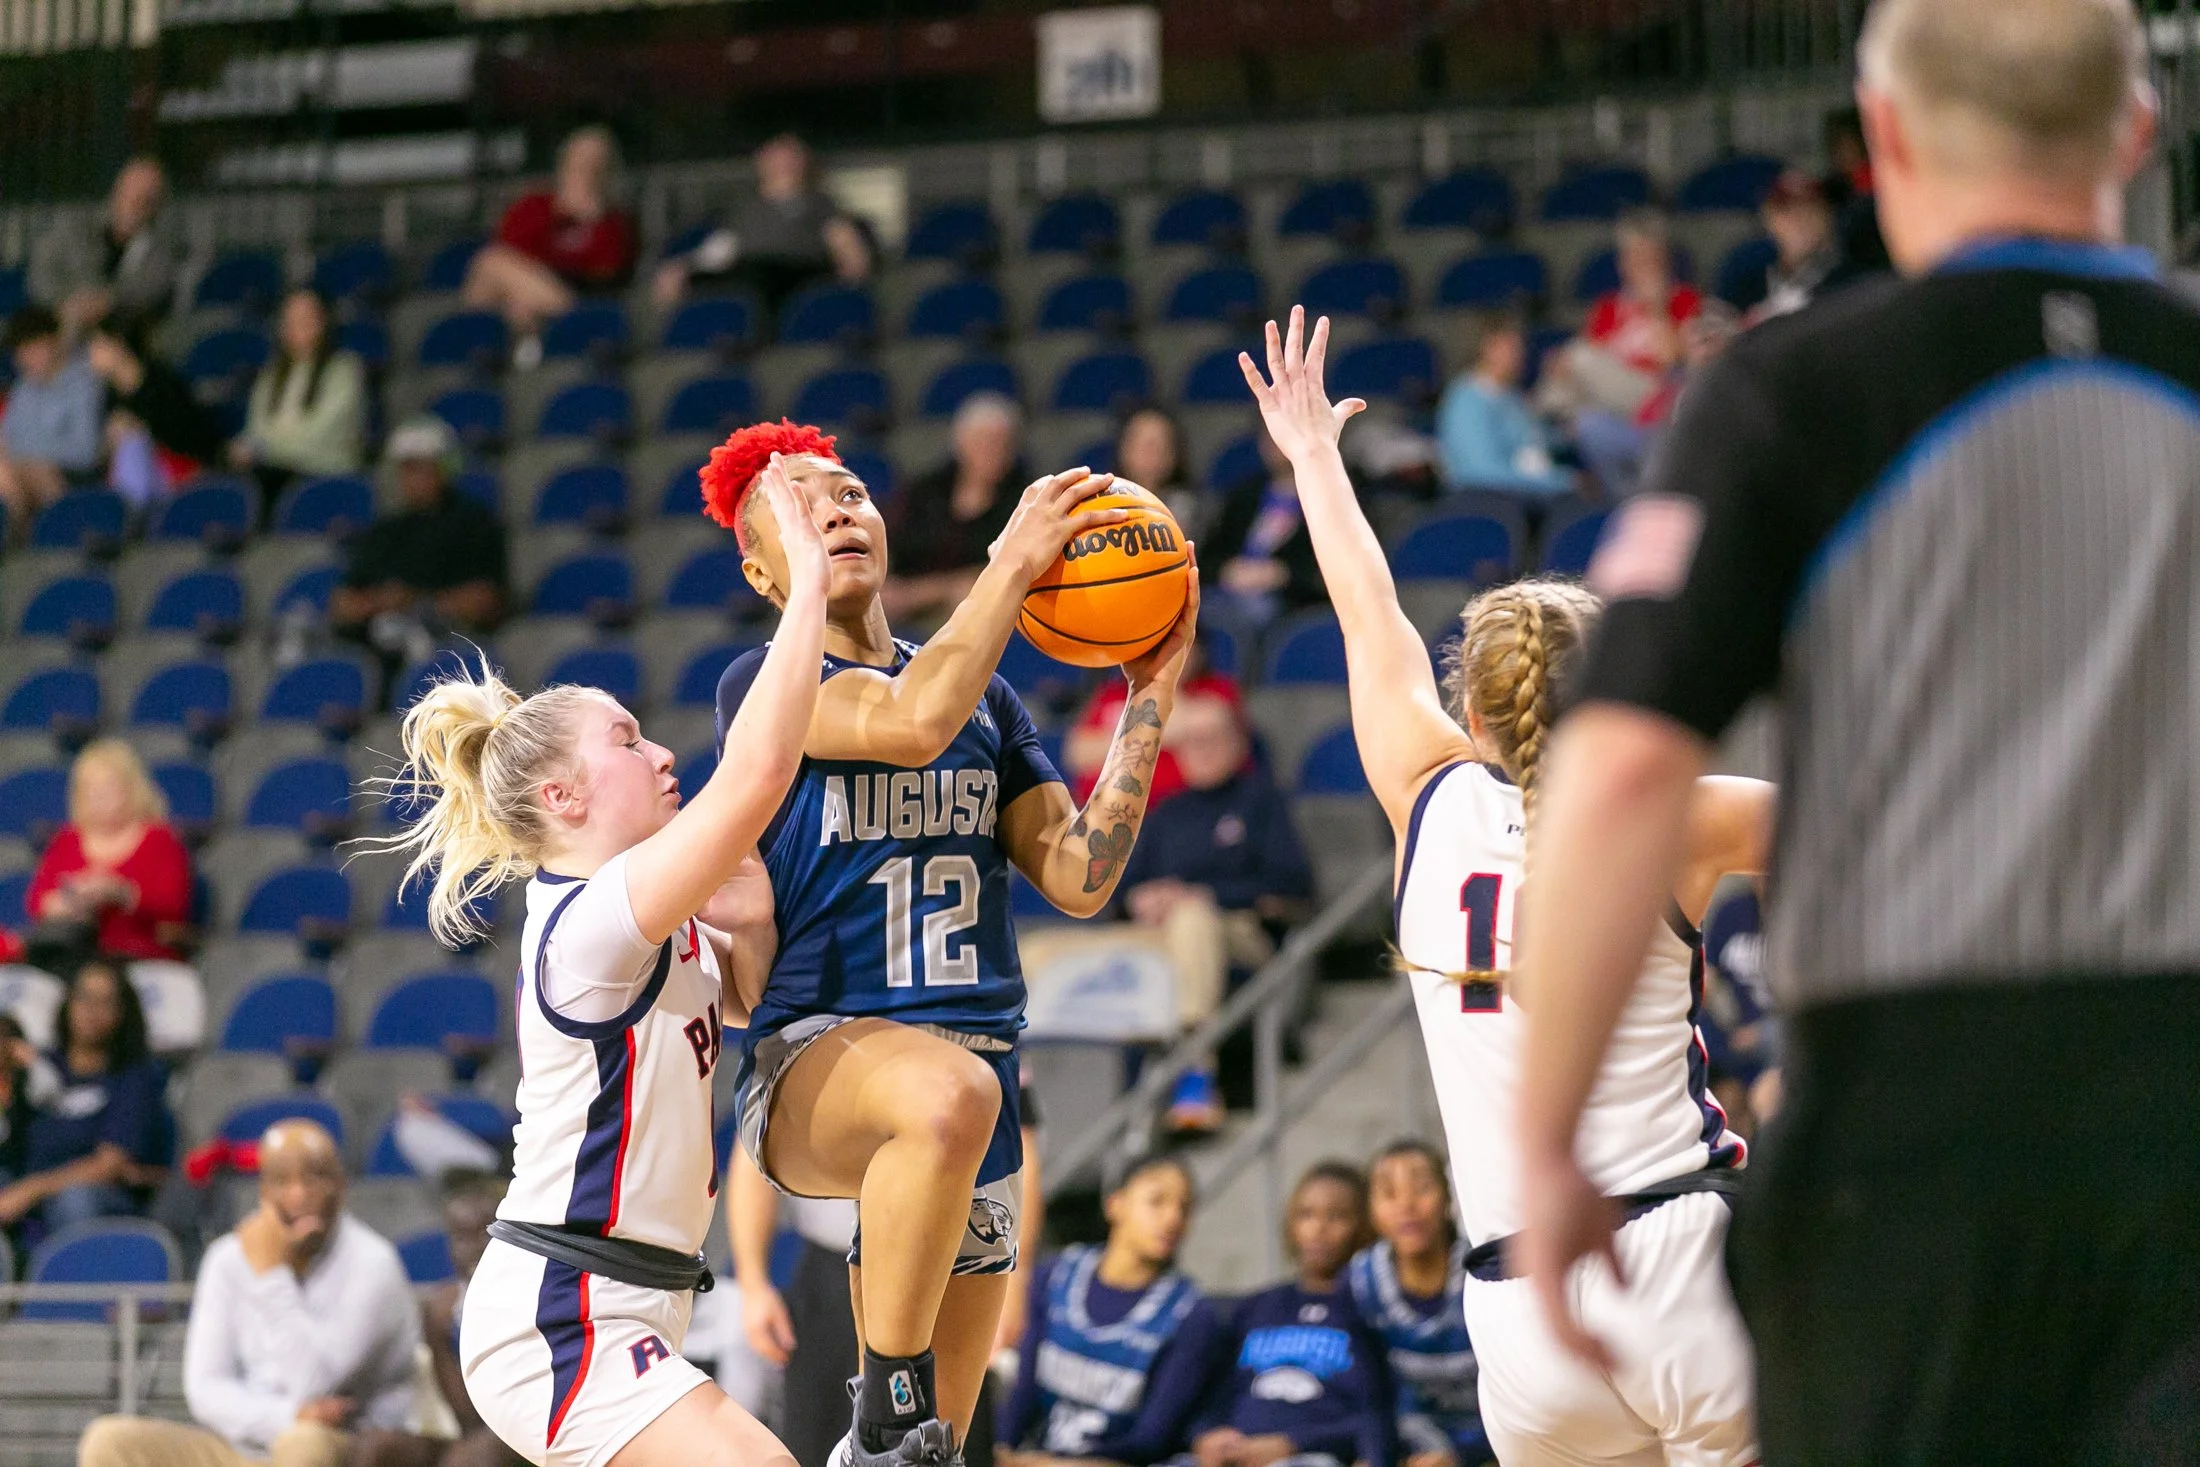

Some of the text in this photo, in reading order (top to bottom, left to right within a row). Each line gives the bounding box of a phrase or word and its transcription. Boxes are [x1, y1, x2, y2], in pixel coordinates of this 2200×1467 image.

[1062, 521, 1178, 563] Wilson
[867, 855, 981, 988] 12
[1459, 871, 1526, 1014] 1
[683, 995, 722, 1080] PA
[627, 1334, 671, 1380] A
